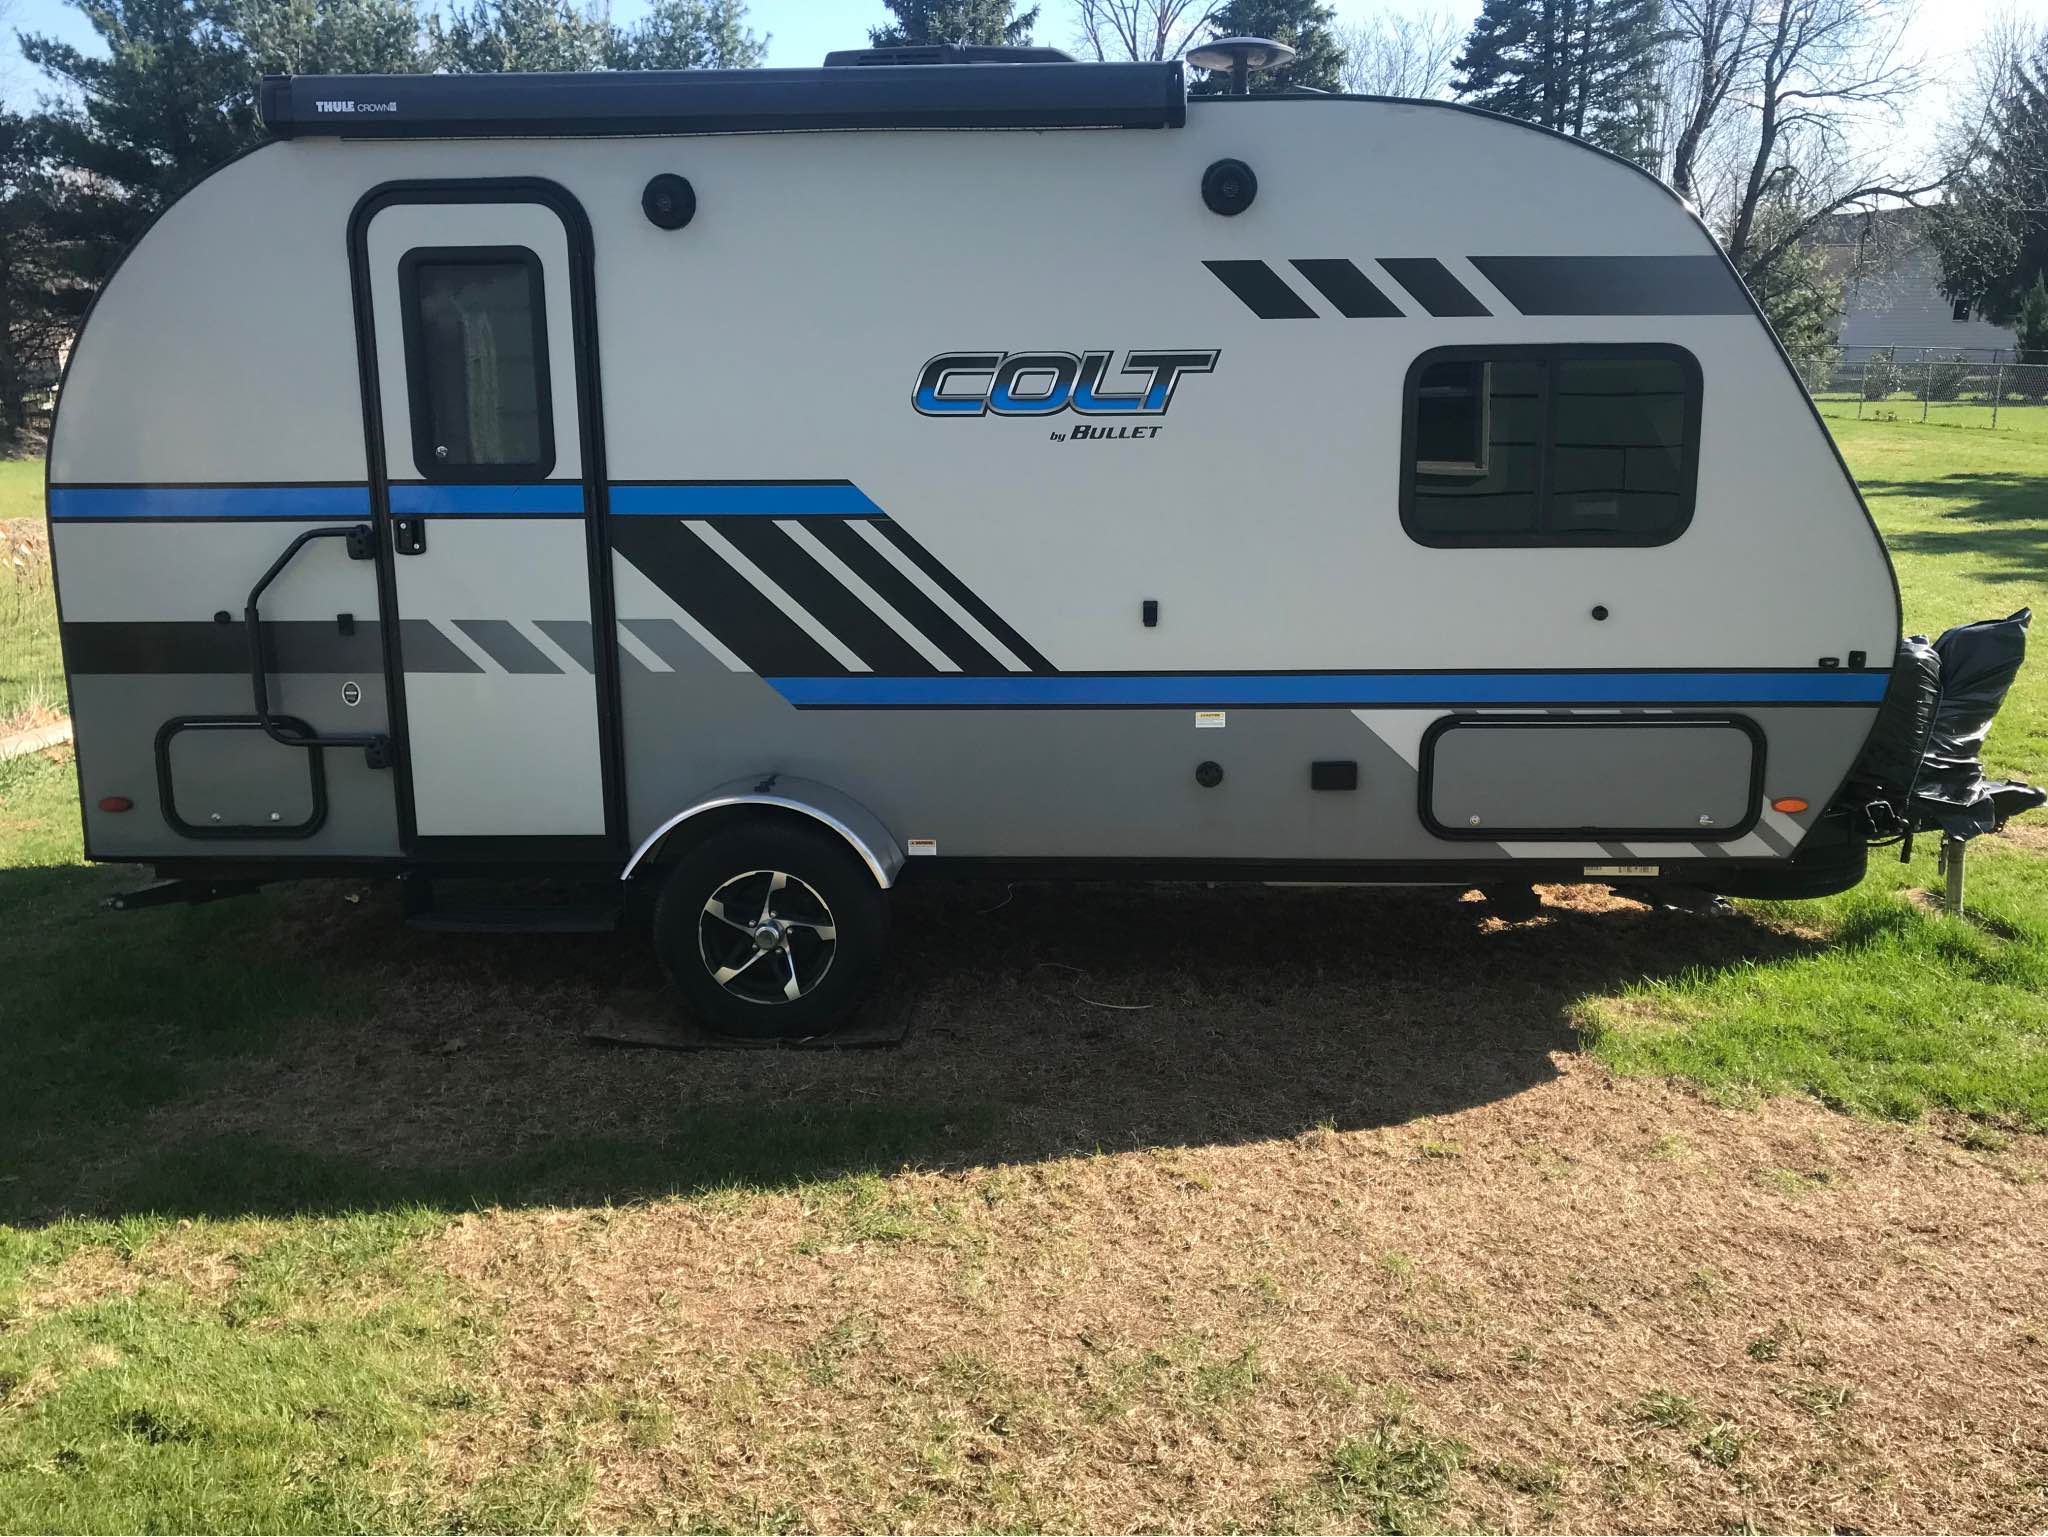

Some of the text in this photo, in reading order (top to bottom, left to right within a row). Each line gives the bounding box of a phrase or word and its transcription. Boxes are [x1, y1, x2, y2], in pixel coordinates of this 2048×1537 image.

[315, 101, 355, 113] THULE
[911, 349, 1222, 418] COLT
[1049, 431, 1066, 443] by
